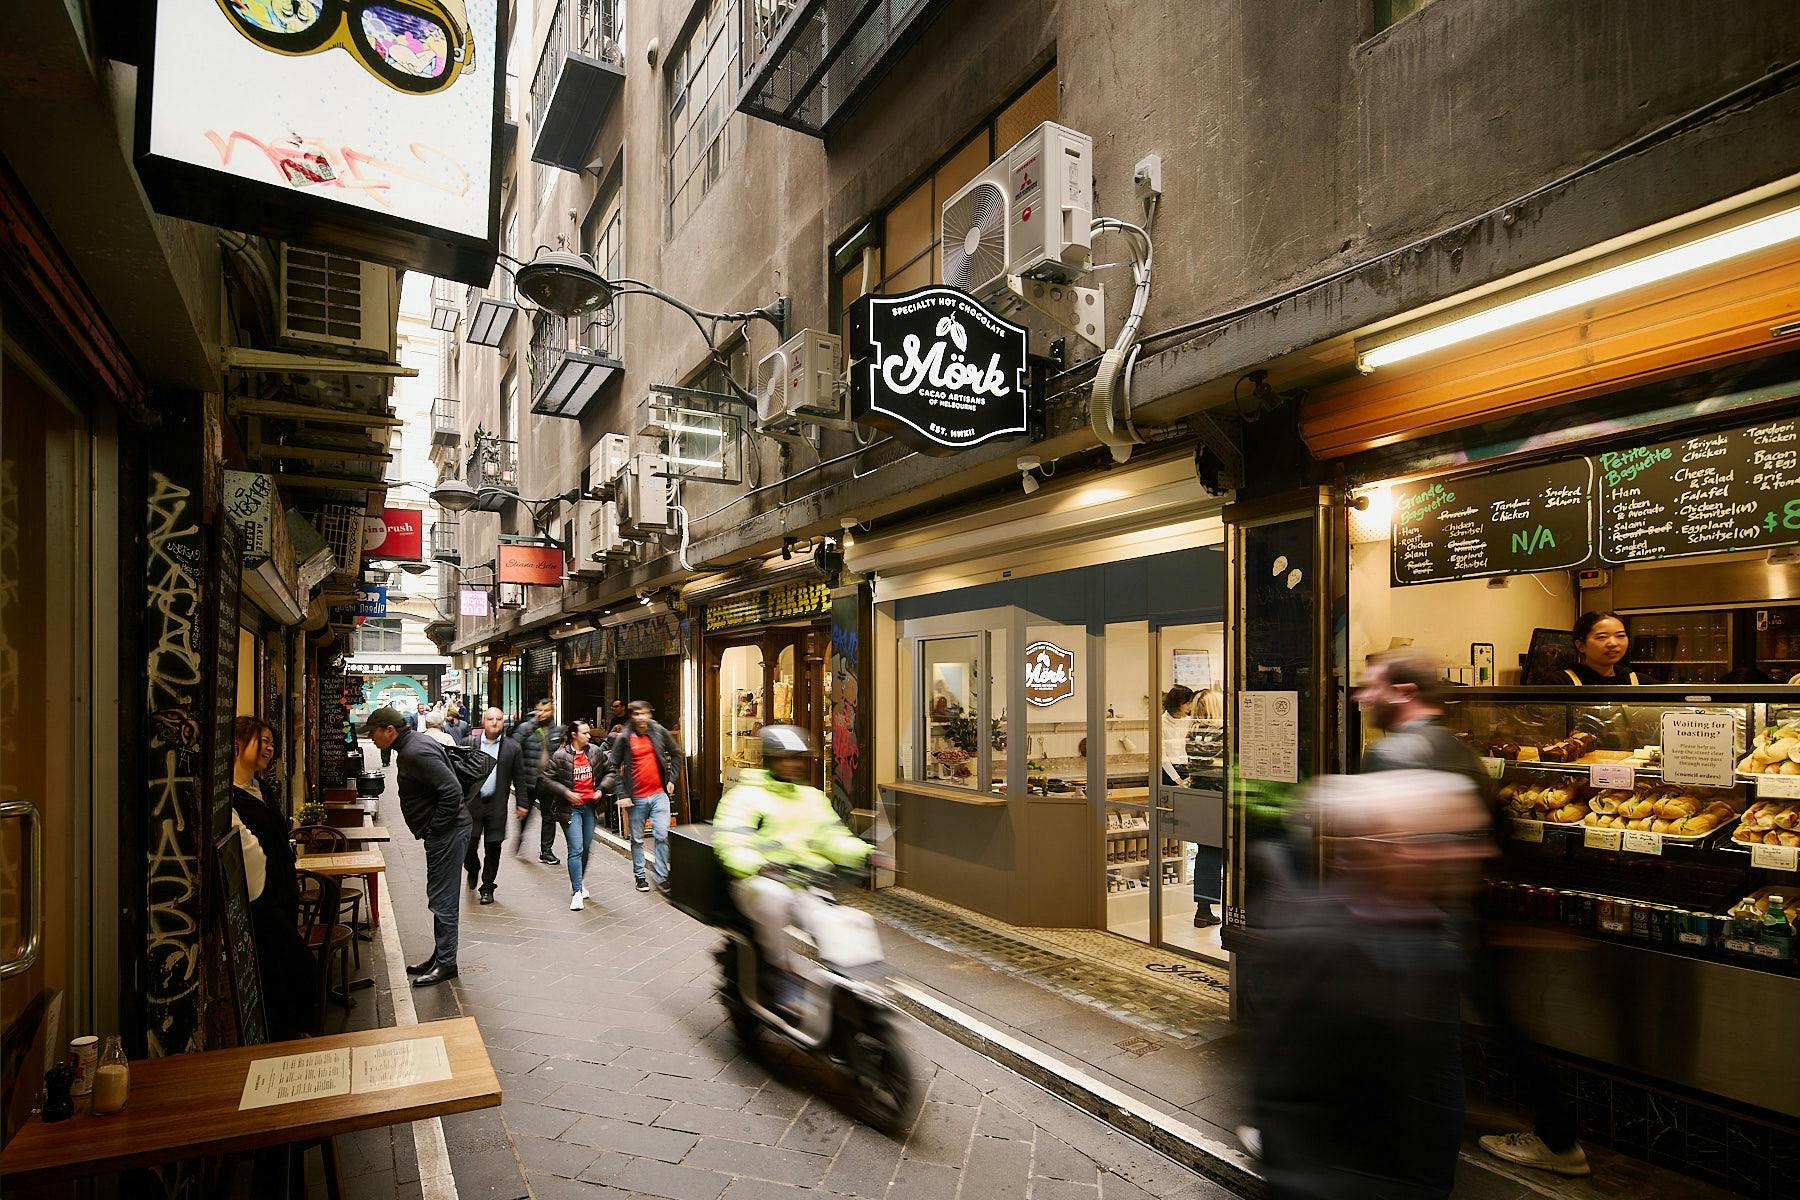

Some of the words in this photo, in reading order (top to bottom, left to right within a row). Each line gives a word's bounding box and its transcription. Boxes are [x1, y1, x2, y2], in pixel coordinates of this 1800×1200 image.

[892, 298, 936, 317] SPECIALTY
[938, 297, 957, 308] HOT
[958, 302, 1006, 338] CHOCOLATE
[882, 333, 1011, 398] Mörk
[918, 388, 947, 400] CACAO
[948, 393, 986, 406] ARTISANS
[928, 398, 939, 406] OF
[939, 400, 977, 412] MELBOURNE
[929, 422, 948, 437] EST.
[1746, 421, 1795, 437] Tandoori
[1686, 435, 1728, 450] Teriyaki
[1753, 433, 1797, 445] Chicken
[1599, 446, 1650, 471] Petite
[1682, 448, 1727, 463] Chicken
[1754, 449, 1797, 465] Bacon
[1605, 448, 1672, 487] Baguette
[1763, 461, 1773, 470] &
[1775, 458, 1797, 470] Egg
[1674, 467, 1716, 482] Cheese
[1690, 479, 1699, 488] &
[1701, 469, 1734, 486] Salad
[1752, 470, 1783, 485] Brie
[1545, 485, 1582, 498] Smoked
[1612, 487, 1641, 500] Ham
[1680, 484, 1730, 504] Falafel
[1760, 482, 1771, 491] &
[1396, 482, 1445, 511] Grande
[1545, 497, 1581, 508] Salmon
[1401, 491, 1456, 525] Baguette
[1613, 499, 1651, 514] Chicken
[1628, 503, 1665, 518] Avocado
[1680, 501, 1723, 515] Chicken
[1491, 510, 1530, 522] Chicken
[387, 522, 414, 533] rush
[1402, 526, 1420, 536] Ham
[1444, 521, 1475, 532] Chicken
[1614, 518, 1646, 532] Salami
[1681, 518, 1735, 534] Eggplant
[1402, 533, 1423, 546] Roast
[1407, 541, 1434, 551] Chicken
[1511, 524, 1556, 555] N/A
[1615, 539, 1648, 554] Smoked
[1404, 549, 1428, 560] Salami
[1450, 551, 1484, 563] Eggplant
[1627, 546, 1666, 558] Salmon
[1673, 720, 1709, 729] Waiting
[1711, 721, 1727, 729] for
[1677, 730, 1721, 739] toasting?
